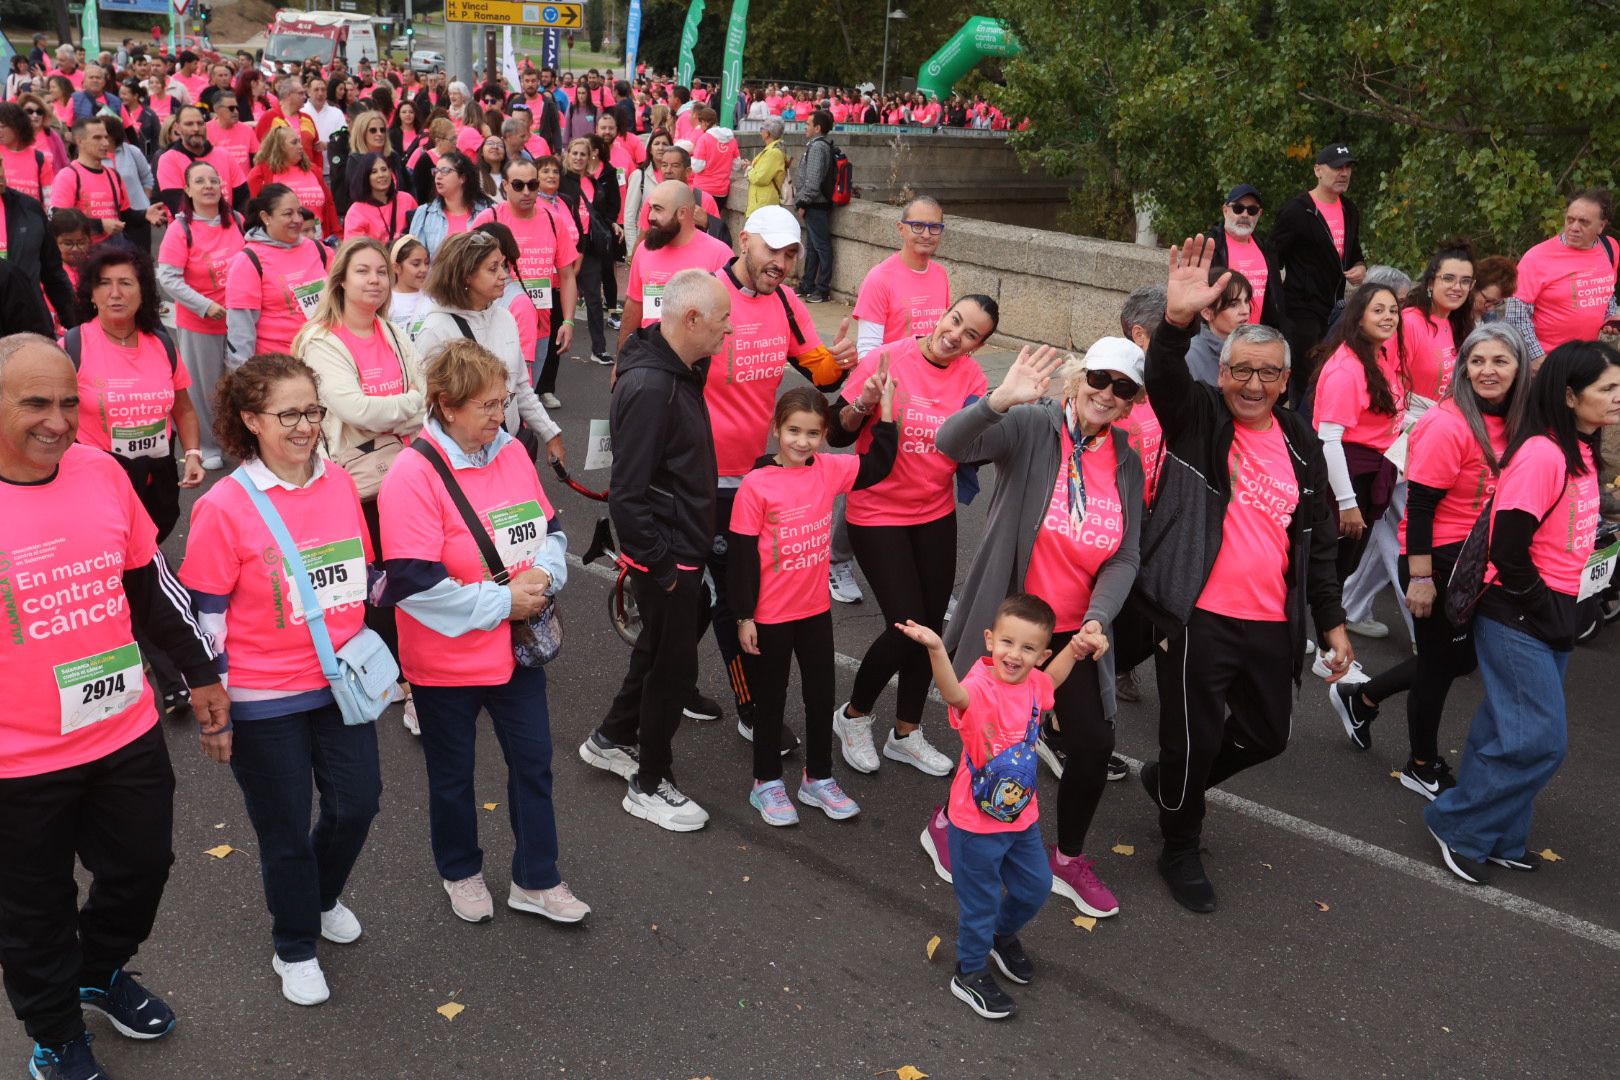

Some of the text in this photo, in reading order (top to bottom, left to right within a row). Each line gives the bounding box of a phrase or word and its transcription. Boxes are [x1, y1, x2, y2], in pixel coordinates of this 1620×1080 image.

[462, 2, 488, 11] Vincci
[474, 12, 511, 21] Romano
[519, 266, 552, 276] áncer
[736, 340, 750, 350] En
[736, 352, 777, 366] contra
[361, 383, 377, 393] En
[107, 391, 125, 402] En
[108, 403, 162, 417] contra
[906, 408, 923, 421] En
[128, 436, 157, 452] 8197
[903, 438, 945, 454] cán
[1085, 494, 1122, 513] archa
[1104, 516, 1120, 532] el
[508, 522, 536, 545] 2973
[780, 526, 798, 540] En
[781, 532, 828, 555] contra
[16, 550, 122, 590] En marcha
[308, 564, 348, 590] 2975
[1590, 560, 1608, 581] 4561
[22, 580, 104, 614] contra
[29, 593, 126, 639] cáncer
[82, 673, 125, 704] 2974
